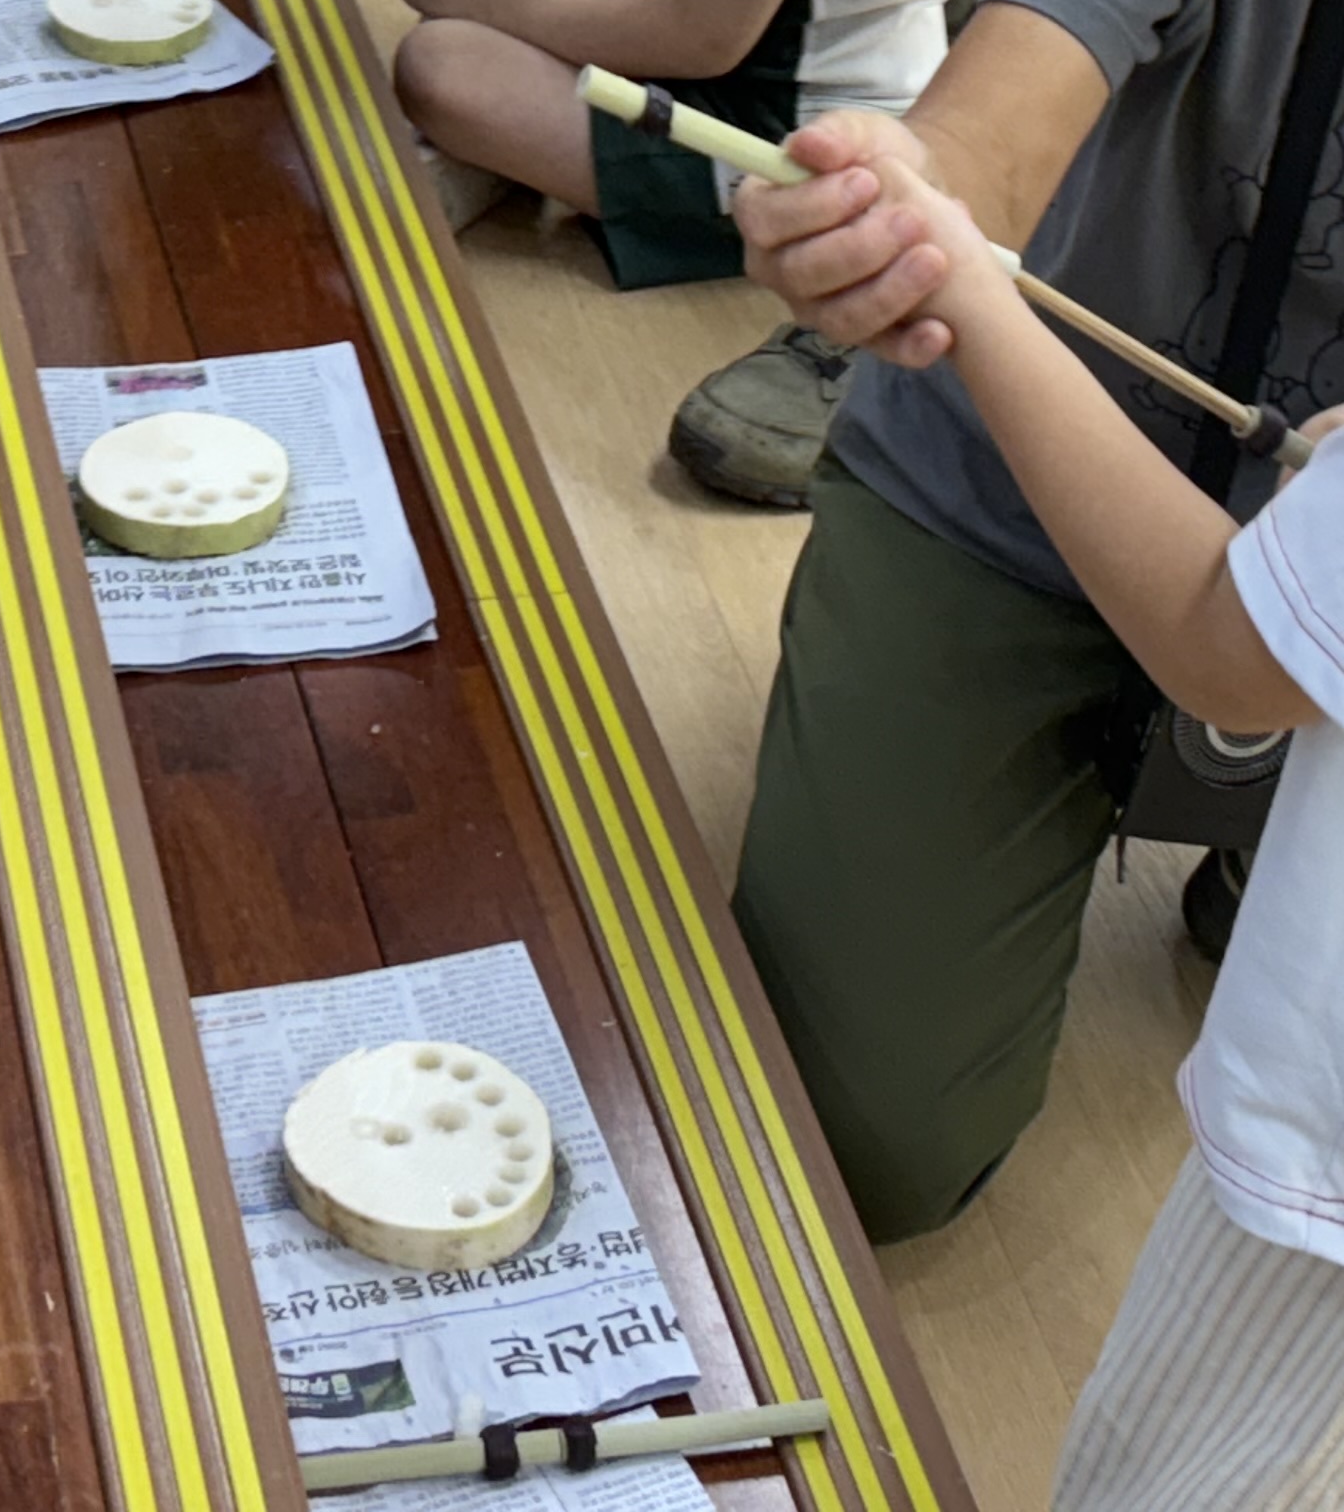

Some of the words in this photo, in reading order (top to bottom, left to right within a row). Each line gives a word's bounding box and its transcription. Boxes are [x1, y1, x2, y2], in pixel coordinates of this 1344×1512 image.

[242, 559, 312, 576] 보랏빛
[149, 583, 219, 602] 무르는
[223, 577, 292, 596] 지나도
[391, 1276, 424, 1301] 등
[426, 1269, 491, 1297] 개정
[324, 1280, 389, 1312] 현안
